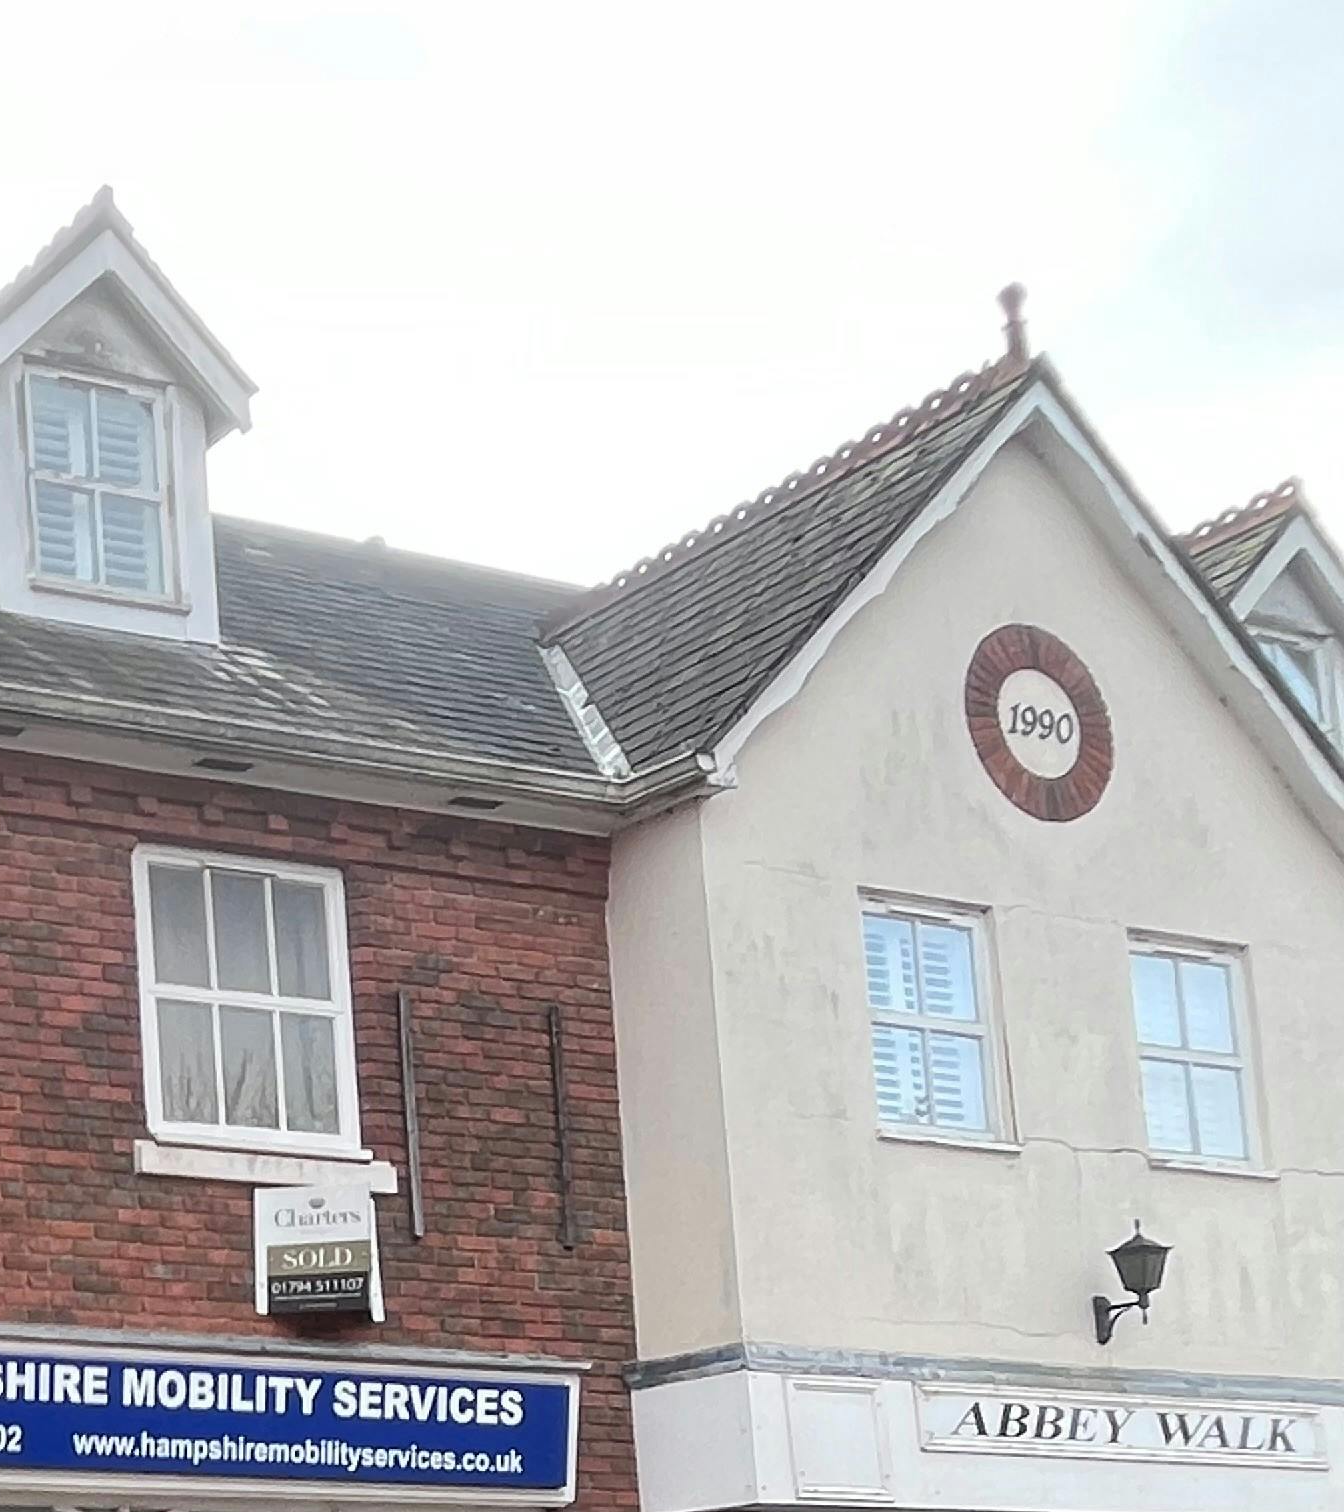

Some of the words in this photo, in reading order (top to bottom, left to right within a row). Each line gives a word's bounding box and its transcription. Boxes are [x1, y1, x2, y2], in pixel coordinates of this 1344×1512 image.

[1007, 701, 1074, 744] 1990
[274, 1207, 362, 1228] Charters
[280, 1246, 352, 1271] SOLD
[271, 1279, 312, 1295] 01794
[315, 1276, 365, 1293] 511107
[121, 1366, 321, 1416] MOBILITY
[332, 1379, 524, 1426] SERVICES
[950, 1401, 1136, 1444] ABBEY
[1157, 1411, 1299, 1453] WALK
[72, 1428, 524, 1474] www.hampshiremobilityservices.co.uk
